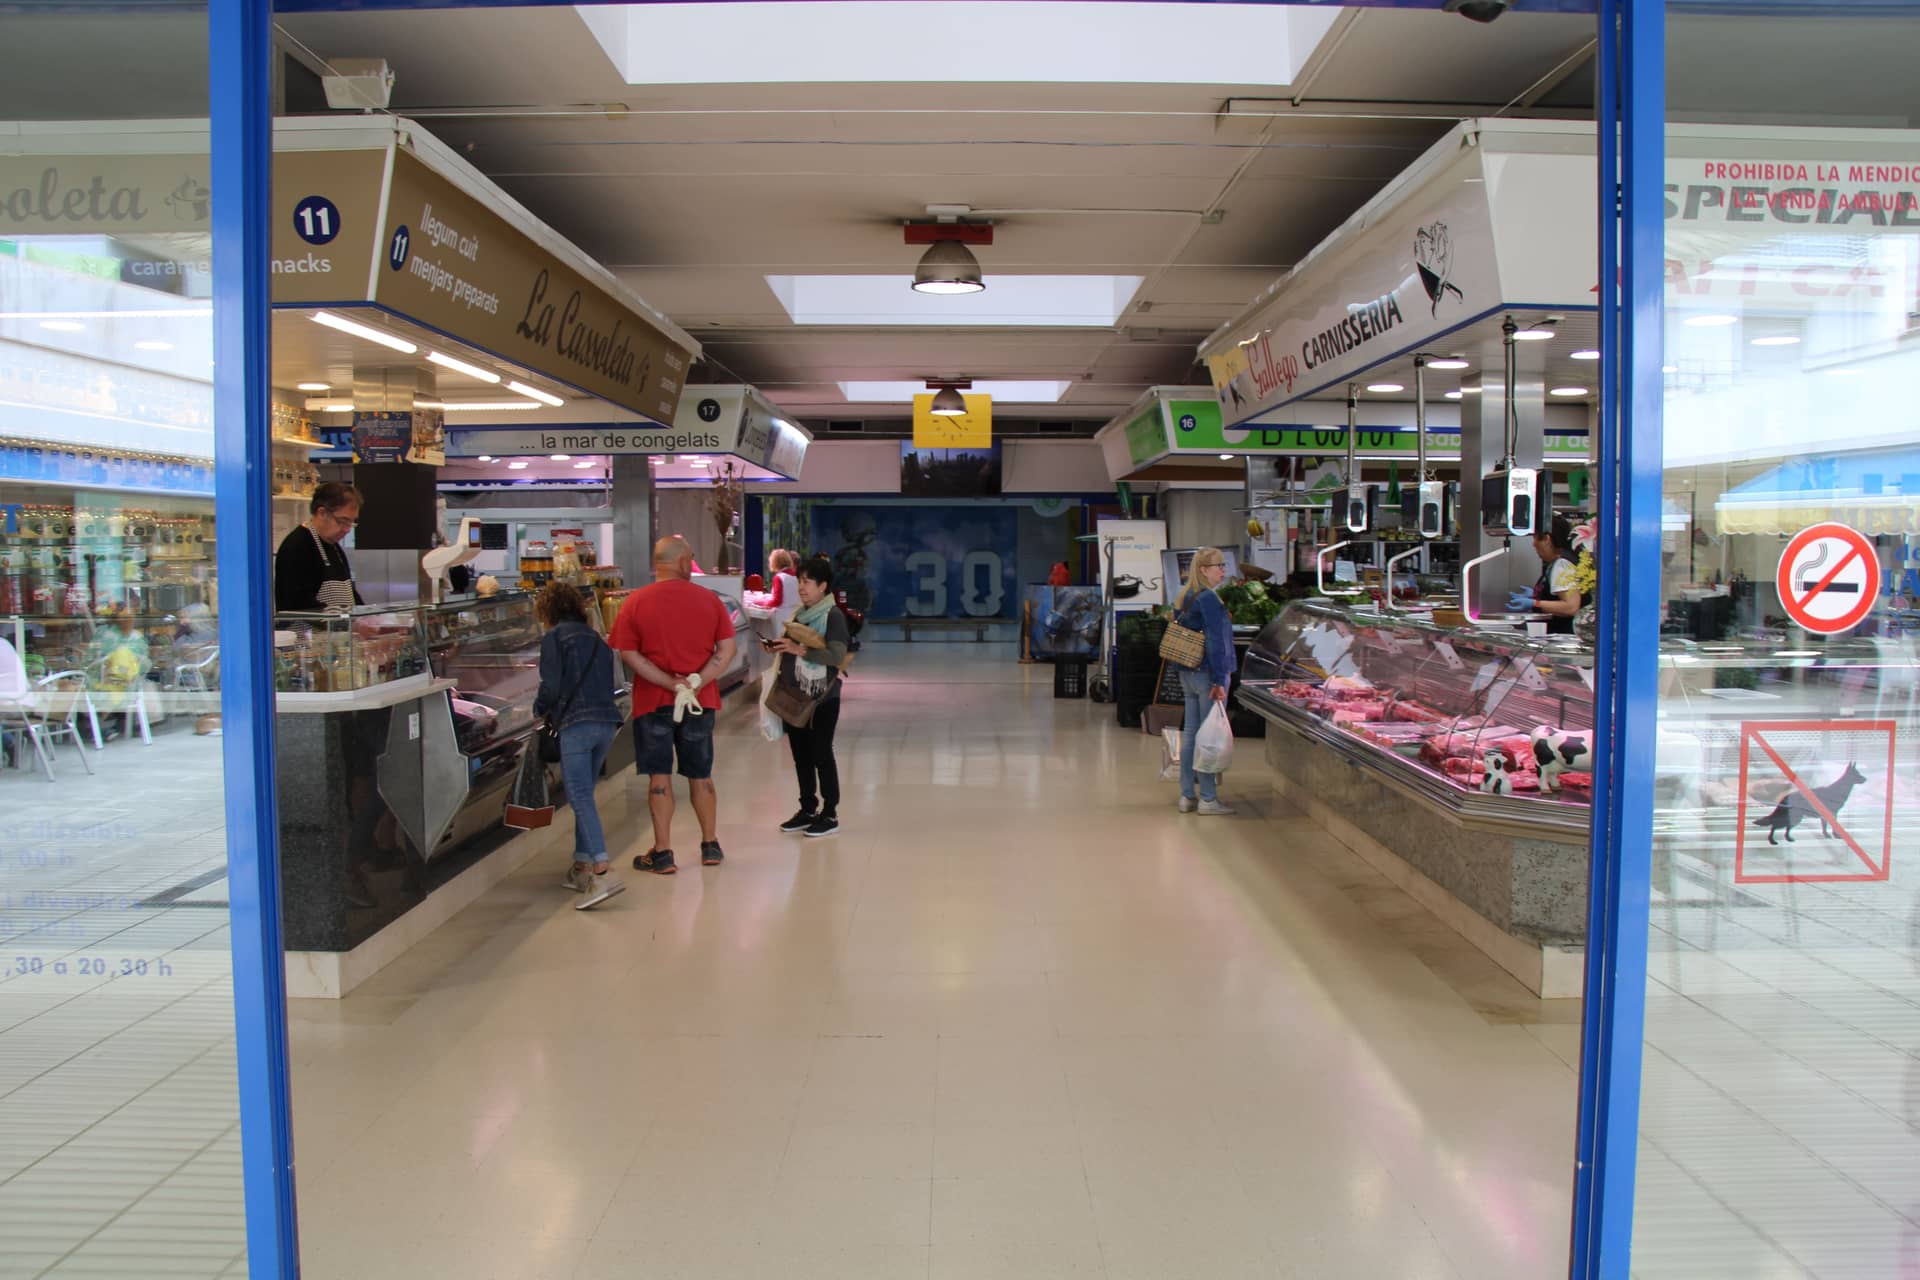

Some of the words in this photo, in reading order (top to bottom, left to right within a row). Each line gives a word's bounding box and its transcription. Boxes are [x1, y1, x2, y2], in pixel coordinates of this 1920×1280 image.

[1704, 162, 1809, 181] PROHIBIDA
[1816, 165, 1840, 182] LA
[1734, 191, 1758, 209] LA
[1766, 192, 1831, 210] VENDA
[1837, 193, 1919, 211] AMBULA
[299, 206, 331, 236] 11
[420, 203, 458, 249] llegum
[458, 235, 480, 262] cuit
[393, 233, 408, 263] 11
[410, 255, 454, 292] menjars
[452, 277, 500, 316] preparats
[516, 269, 555, 348] La
[1247, 335, 1299, 400] Gallego
[1303, 291, 1404, 370] CARNISSERIA
[702, 405, 716, 417] 17
[1181, 417, 1194, 429] 16
[541, 432, 557, 449] la
[563, 436, 598, 449] mar
[603, 432, 626, 449] de
[632, 431, 720, 452] congelats
[904, 551, 1005, 616] 30
[54, 962, 68, 975] a
[78, 957, 149, 978] 20,30
[159, 959, 173, 977] h
